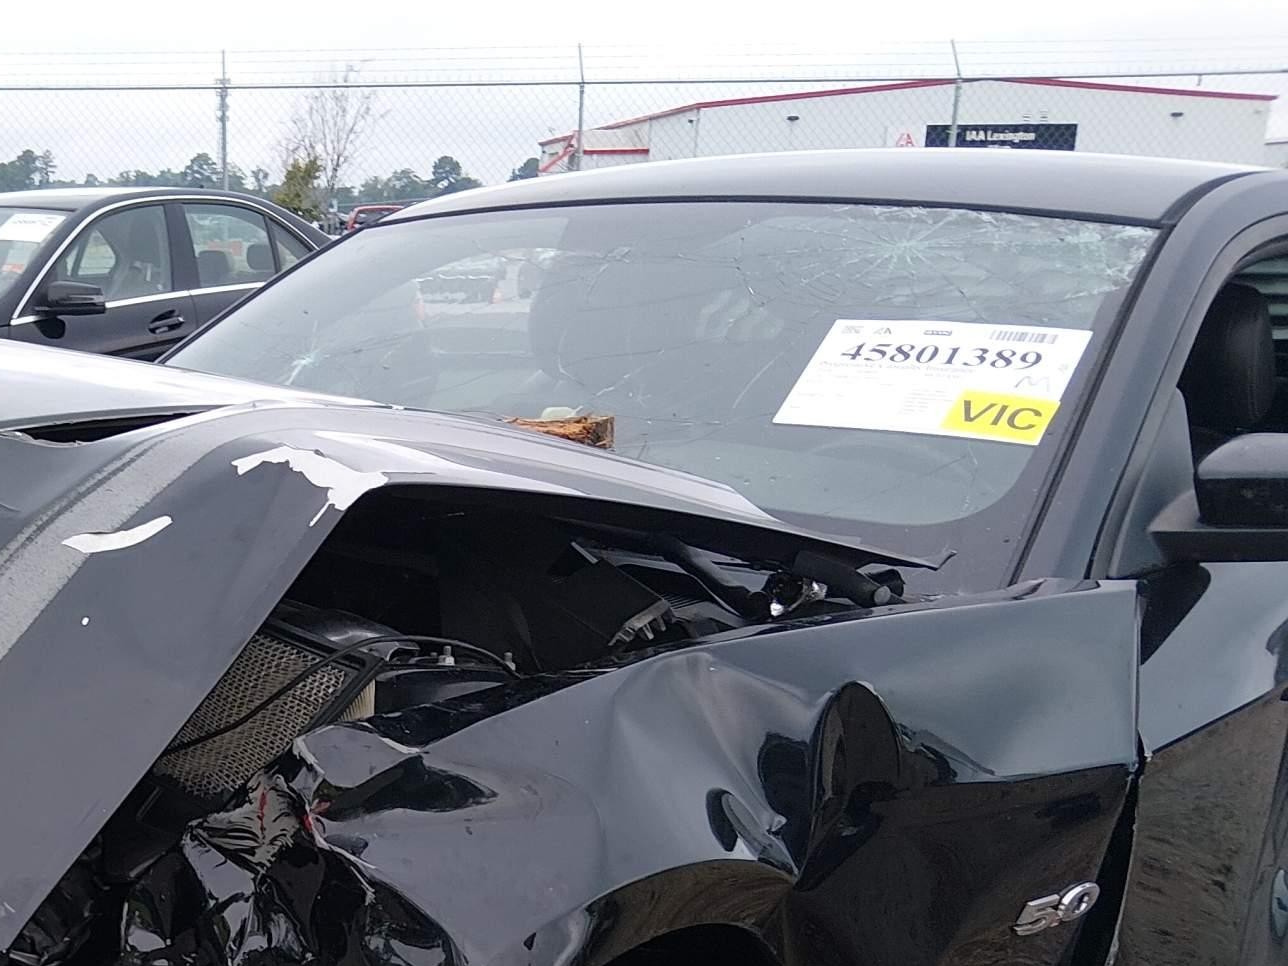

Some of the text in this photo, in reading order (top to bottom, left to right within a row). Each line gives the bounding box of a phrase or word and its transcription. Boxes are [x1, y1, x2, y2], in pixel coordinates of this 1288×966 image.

[965, 128, 1036, 143] IAA Lexington
[840, 342, 1042, 370] 45801389
[962, 399, 1043, 431] VIC
